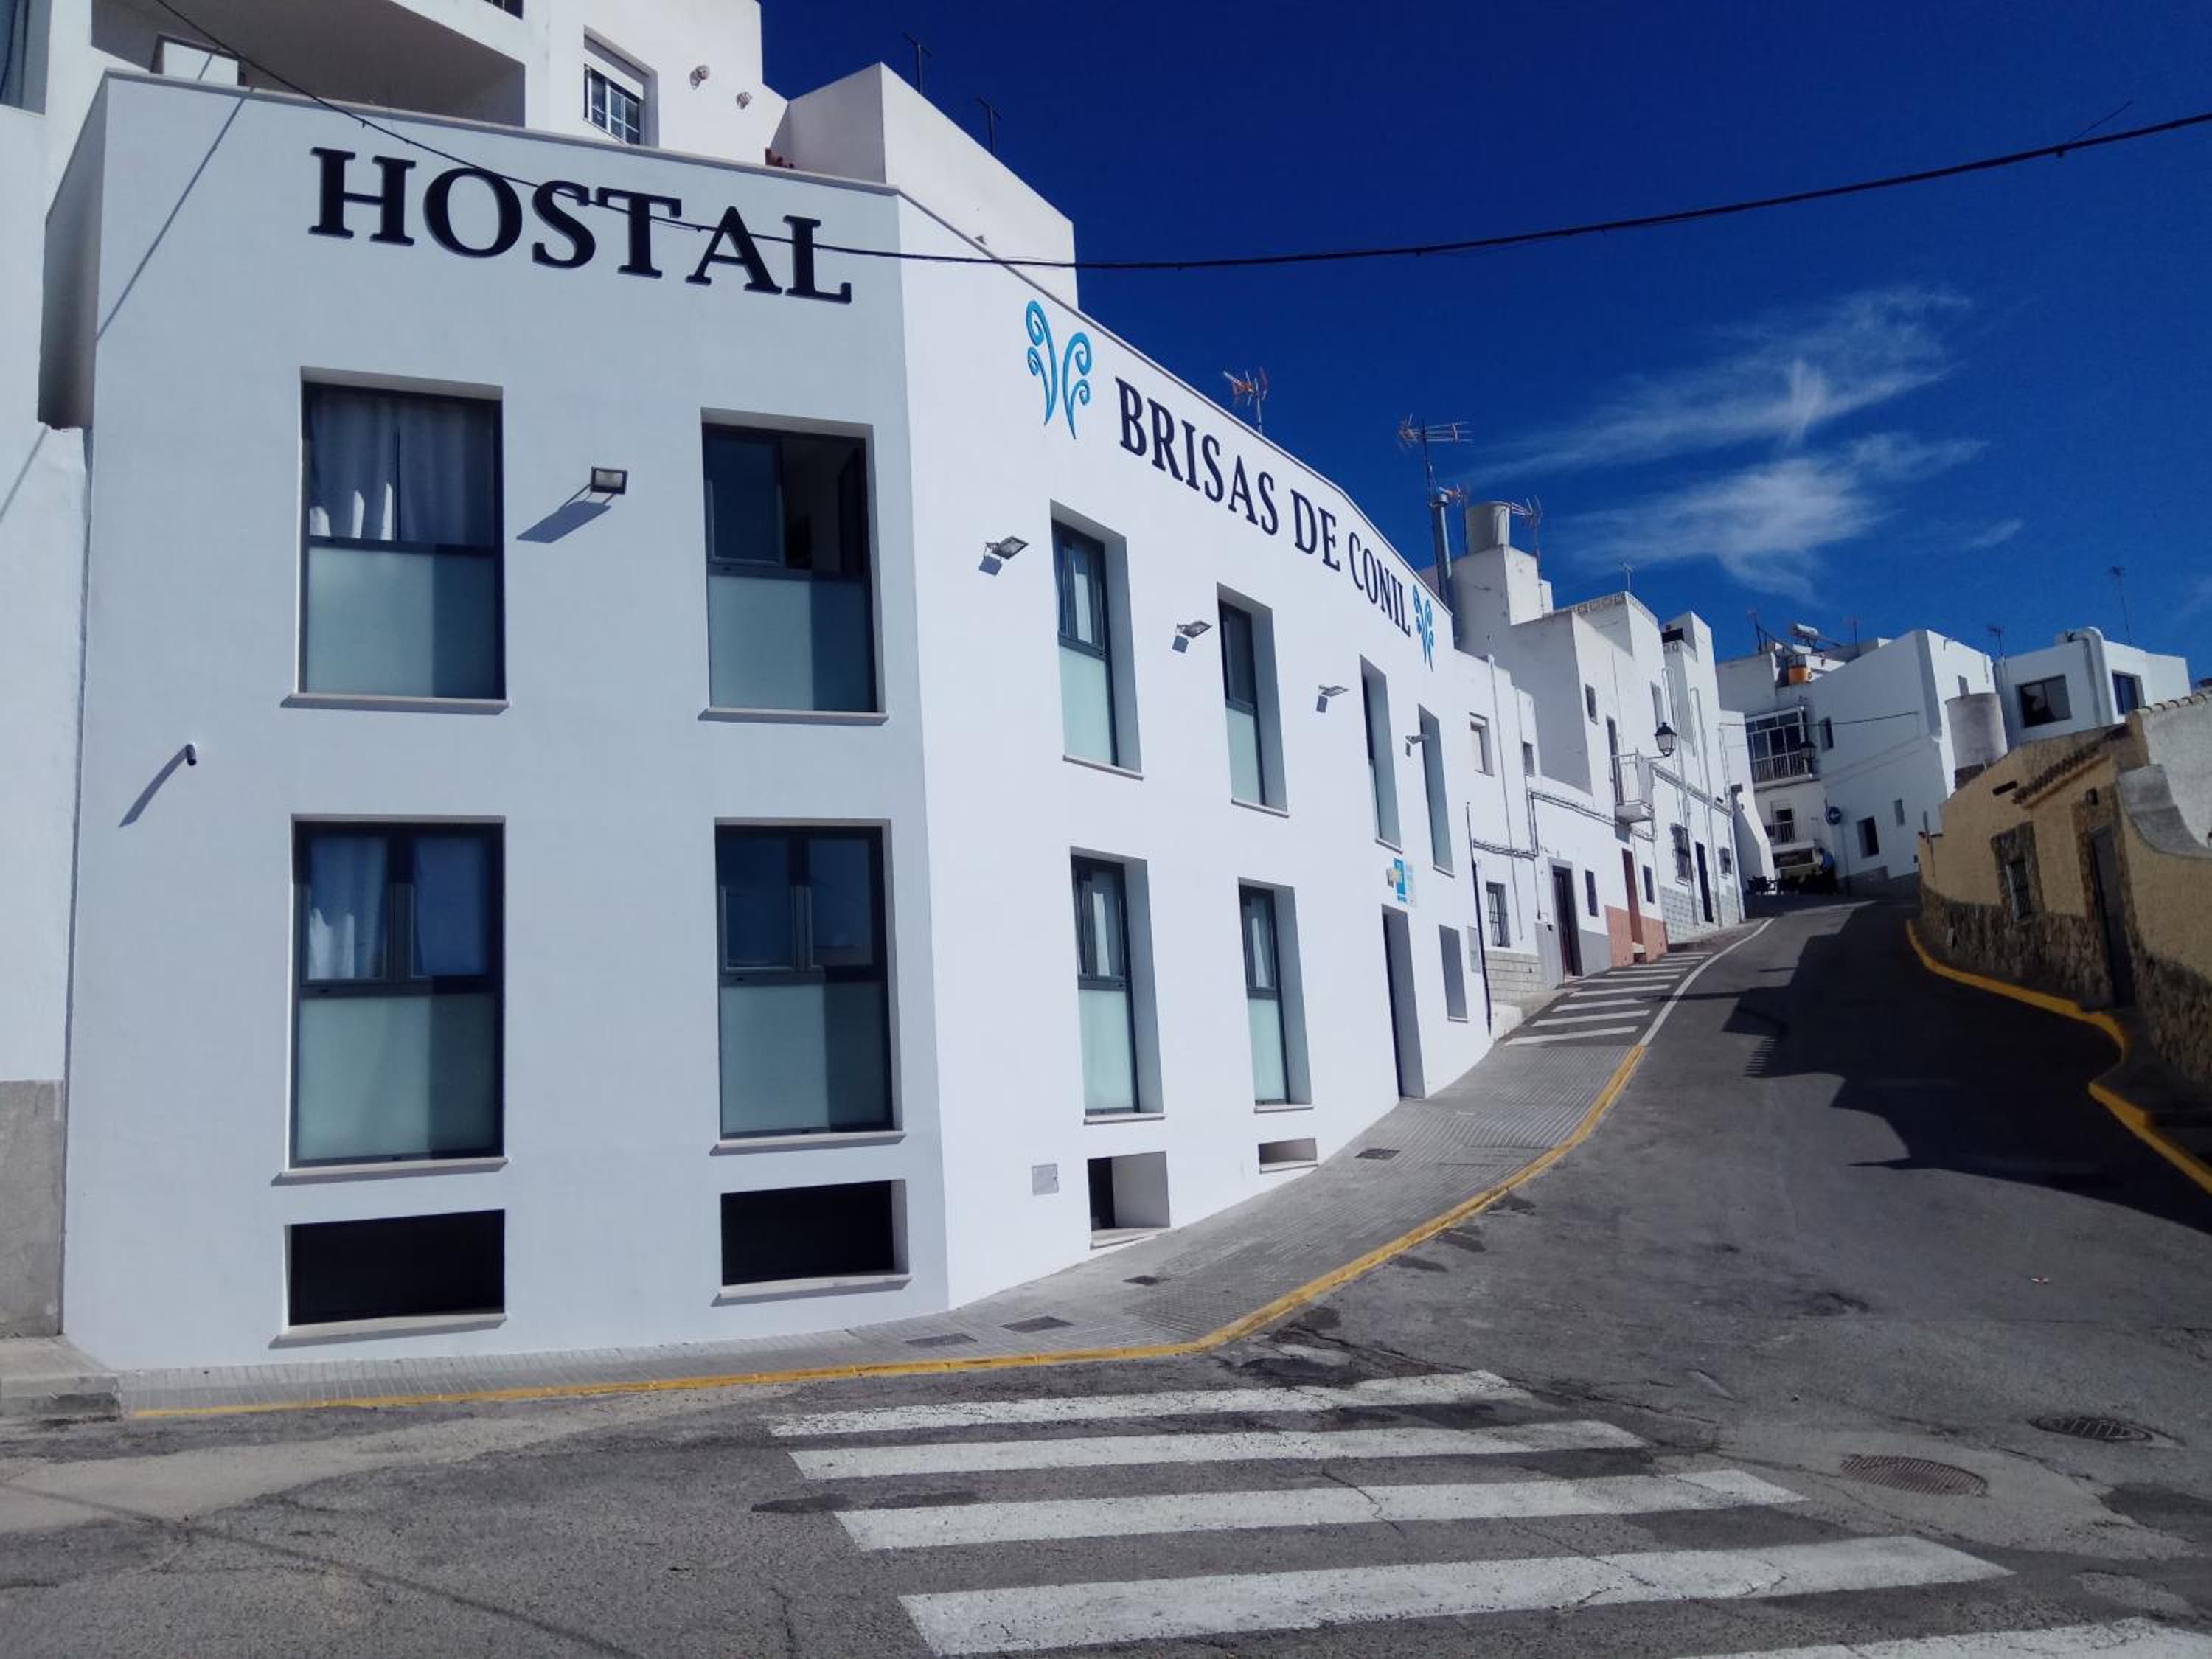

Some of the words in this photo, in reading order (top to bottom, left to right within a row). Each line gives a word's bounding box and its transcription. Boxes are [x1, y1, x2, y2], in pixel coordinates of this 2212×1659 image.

[308, 147, 852, 304] HOSTAL
[1115, 376, 1279, 537] BRISAS
[1290, 488, 1341, 572] DE
[1348, 532, 1411, 639] CONIL
